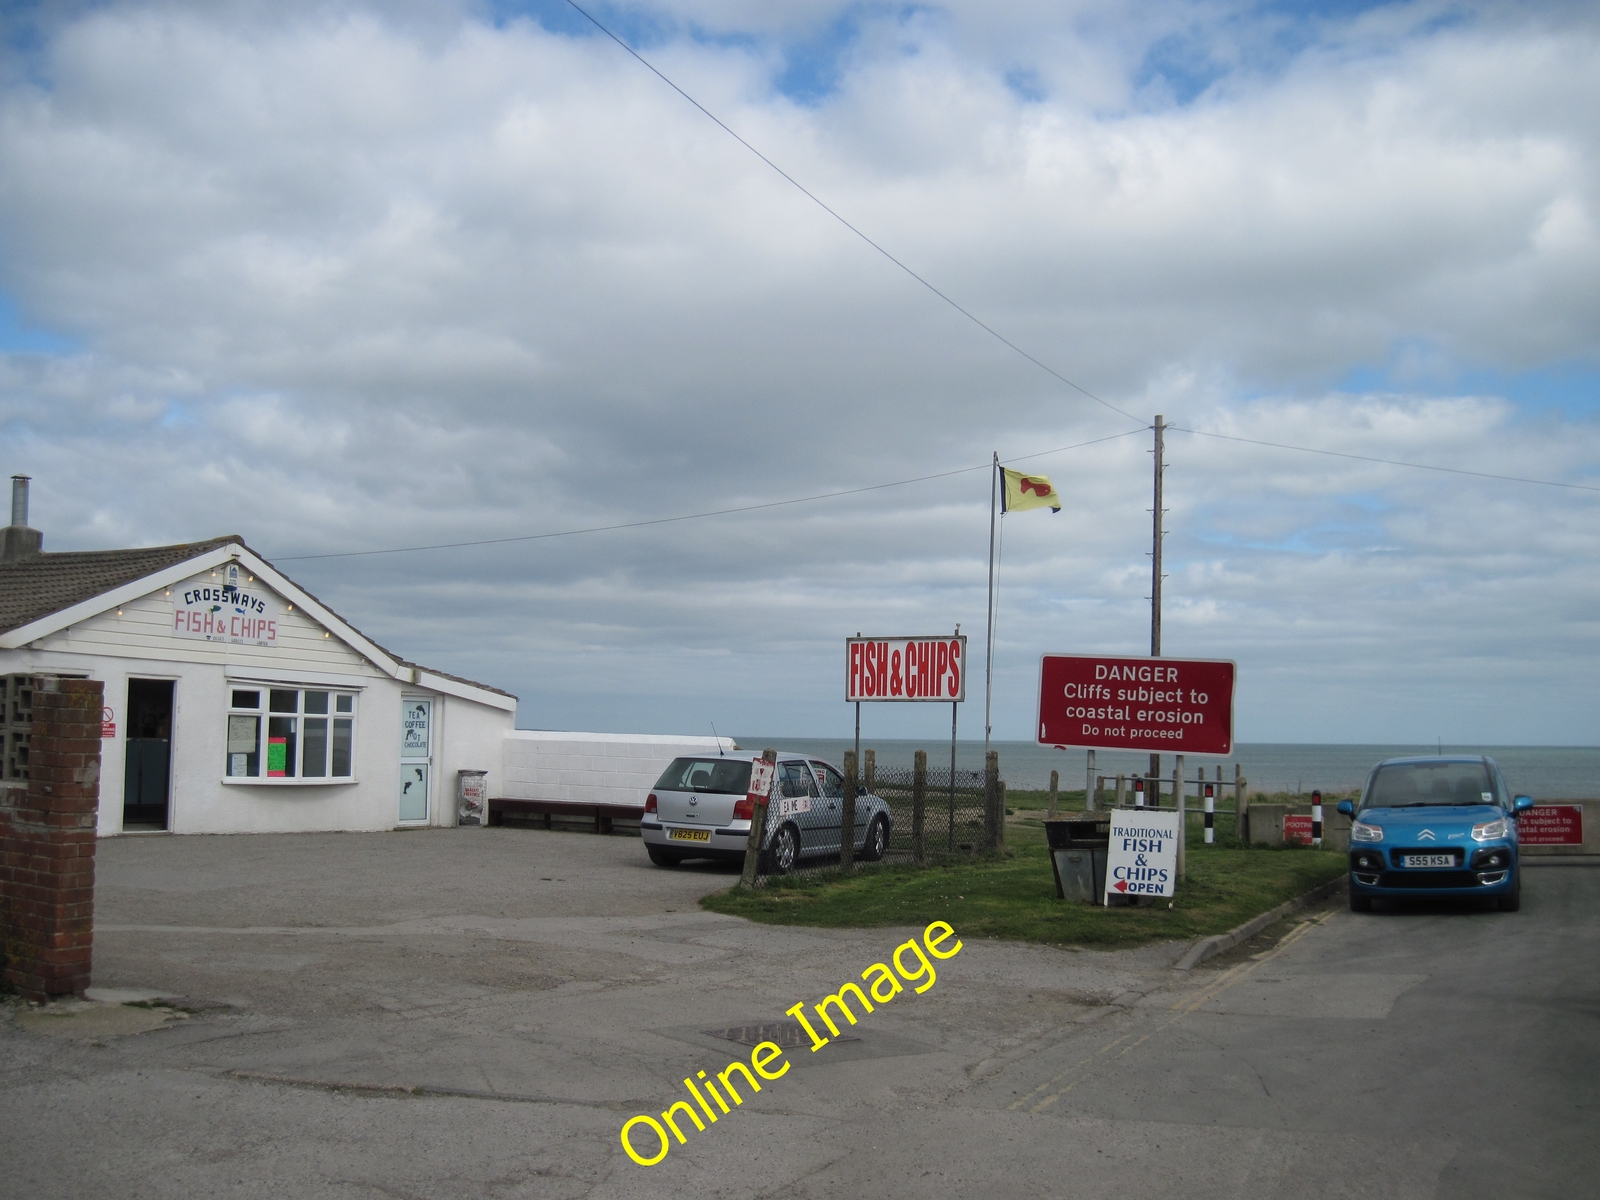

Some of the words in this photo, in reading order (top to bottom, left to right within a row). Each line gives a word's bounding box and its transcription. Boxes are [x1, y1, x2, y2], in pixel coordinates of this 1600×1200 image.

[184, 588, 266, 614] CROSSWAYS
[175, 610, 214, 634] FISH
[217, 619, 226, 634] &
[230, 616, 276, 640] CHIPS
[850, 641, 889, 697] FISH
[890, 649, 903, 697] &
[905, 640, 960, 698] CHIPS
[1095, 664, 1179, 683] DANGER
[1063, 682, 1111, 700] Cliffs
[1117, 686, 1183, 705] subject
[1190, 688, 1209, 705] to
[408, 711, 420, 719] TEA
[1066, 705, 1130, 721] coastal
[1136, 708, 1204, 724] erosion
[404, 720, 426, 729] COFFEE
[1082, 723, 1099, 736] Do
[1104, 725, 1126, 737] not
[1130, 727, 1183, 740] proceed
[1530, 817, 1560, 826] subject
[1562, 817, 1572, 825] to
[693, 831, 709, 841] EUJ
[1112, 827, 1174, 840] TRADITIONAL
[1539, 825, 1570, 833] erosion
[1123, 838, 1163, 853] FISH
[1134, 853, 1148, 867] &
[1409, 856, 1428, 866] S55
[1430, 856, 1450, 866] KSA
[1113, 866, 1169, 882] CHIPS
[1128, 882, 1164, 894] OPEN
